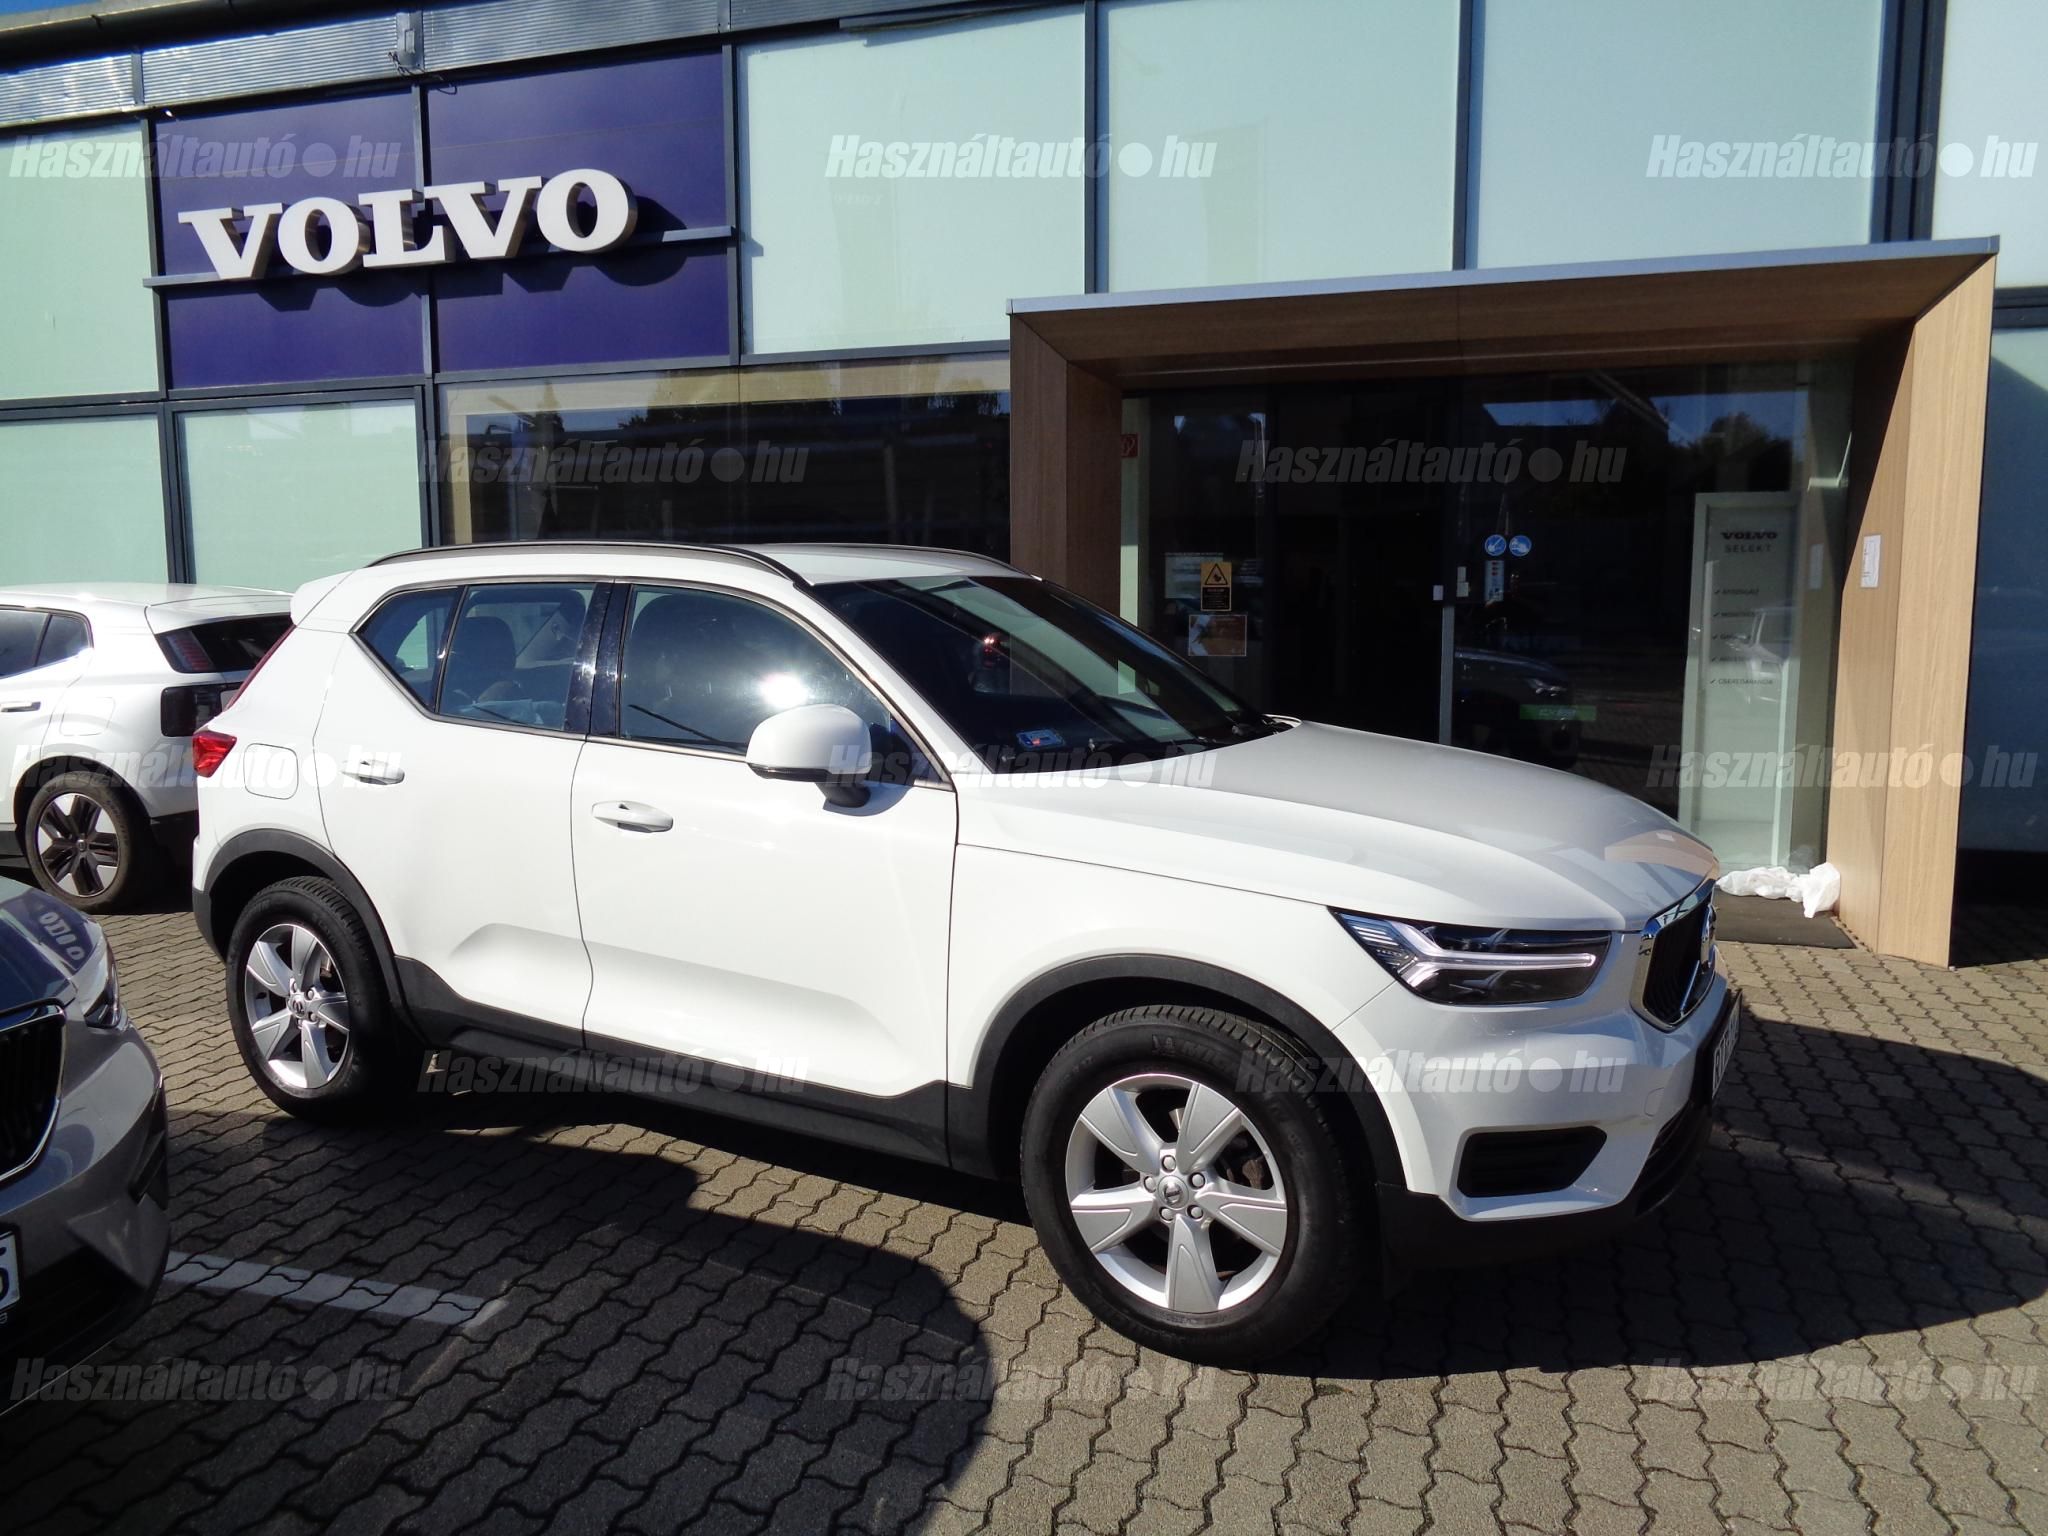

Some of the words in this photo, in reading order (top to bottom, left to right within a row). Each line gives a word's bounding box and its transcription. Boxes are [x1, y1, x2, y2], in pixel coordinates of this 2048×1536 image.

[179, 168, 637, 280] VOLVO
[1723, 532, 1777, 540] VOLVO
[1725, 544, 1772, 554] SELEKT
